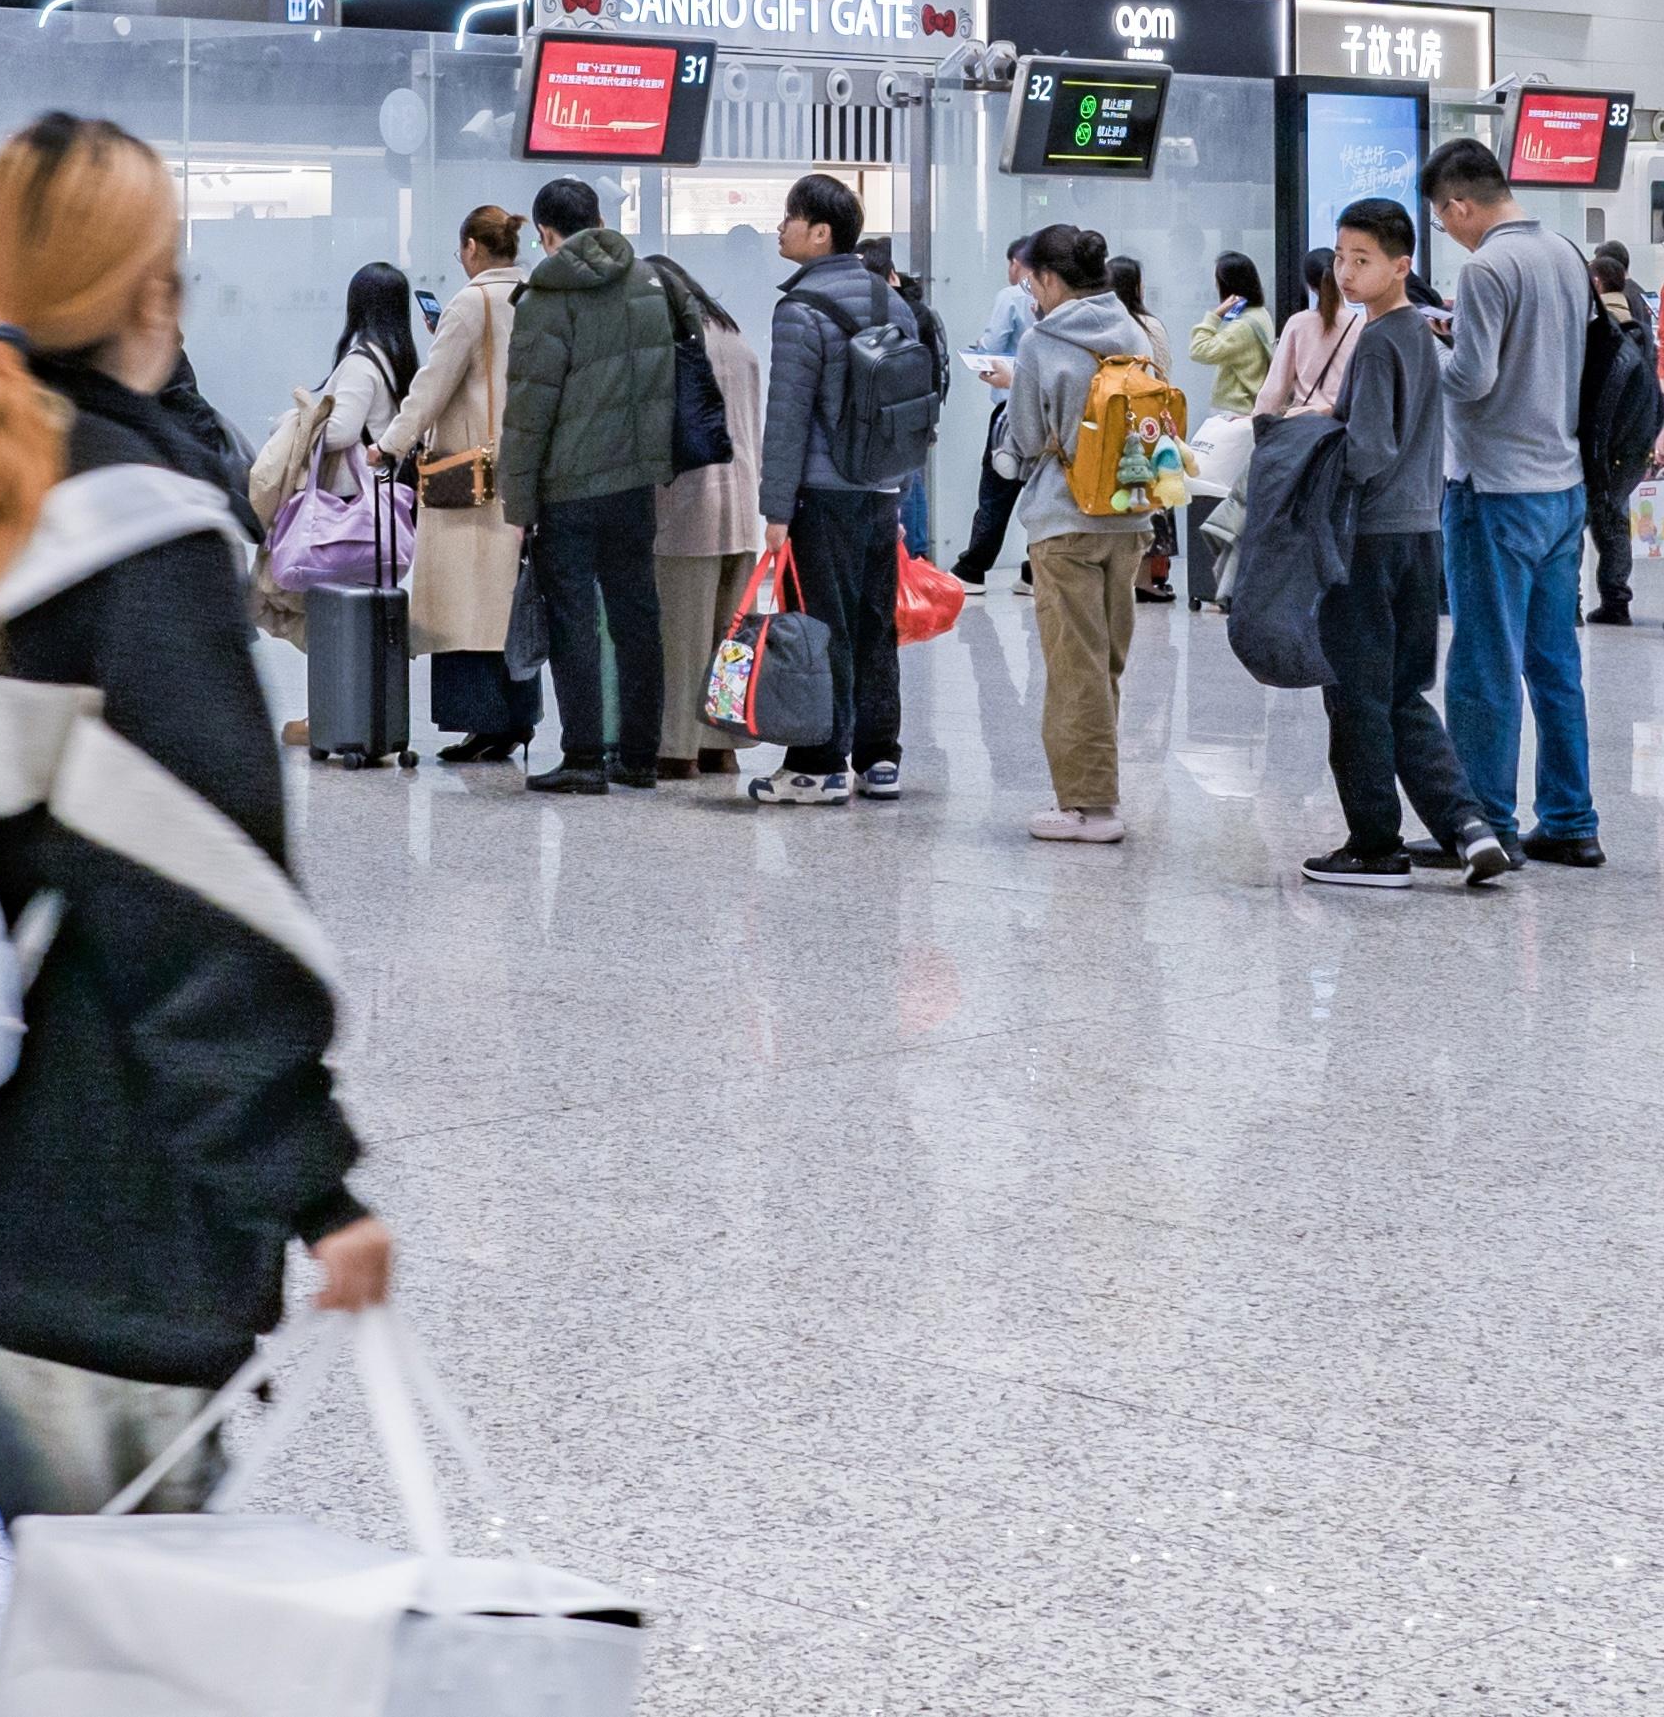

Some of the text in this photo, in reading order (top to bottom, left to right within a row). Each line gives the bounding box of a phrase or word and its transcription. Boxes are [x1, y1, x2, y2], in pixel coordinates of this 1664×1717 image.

[1340, 24, 1443, 80] 子故书房
[681, 55, 707, 84] 31
[1028, 75, 1053, 101] 32
[1608, 103, 1629, 126] 33
